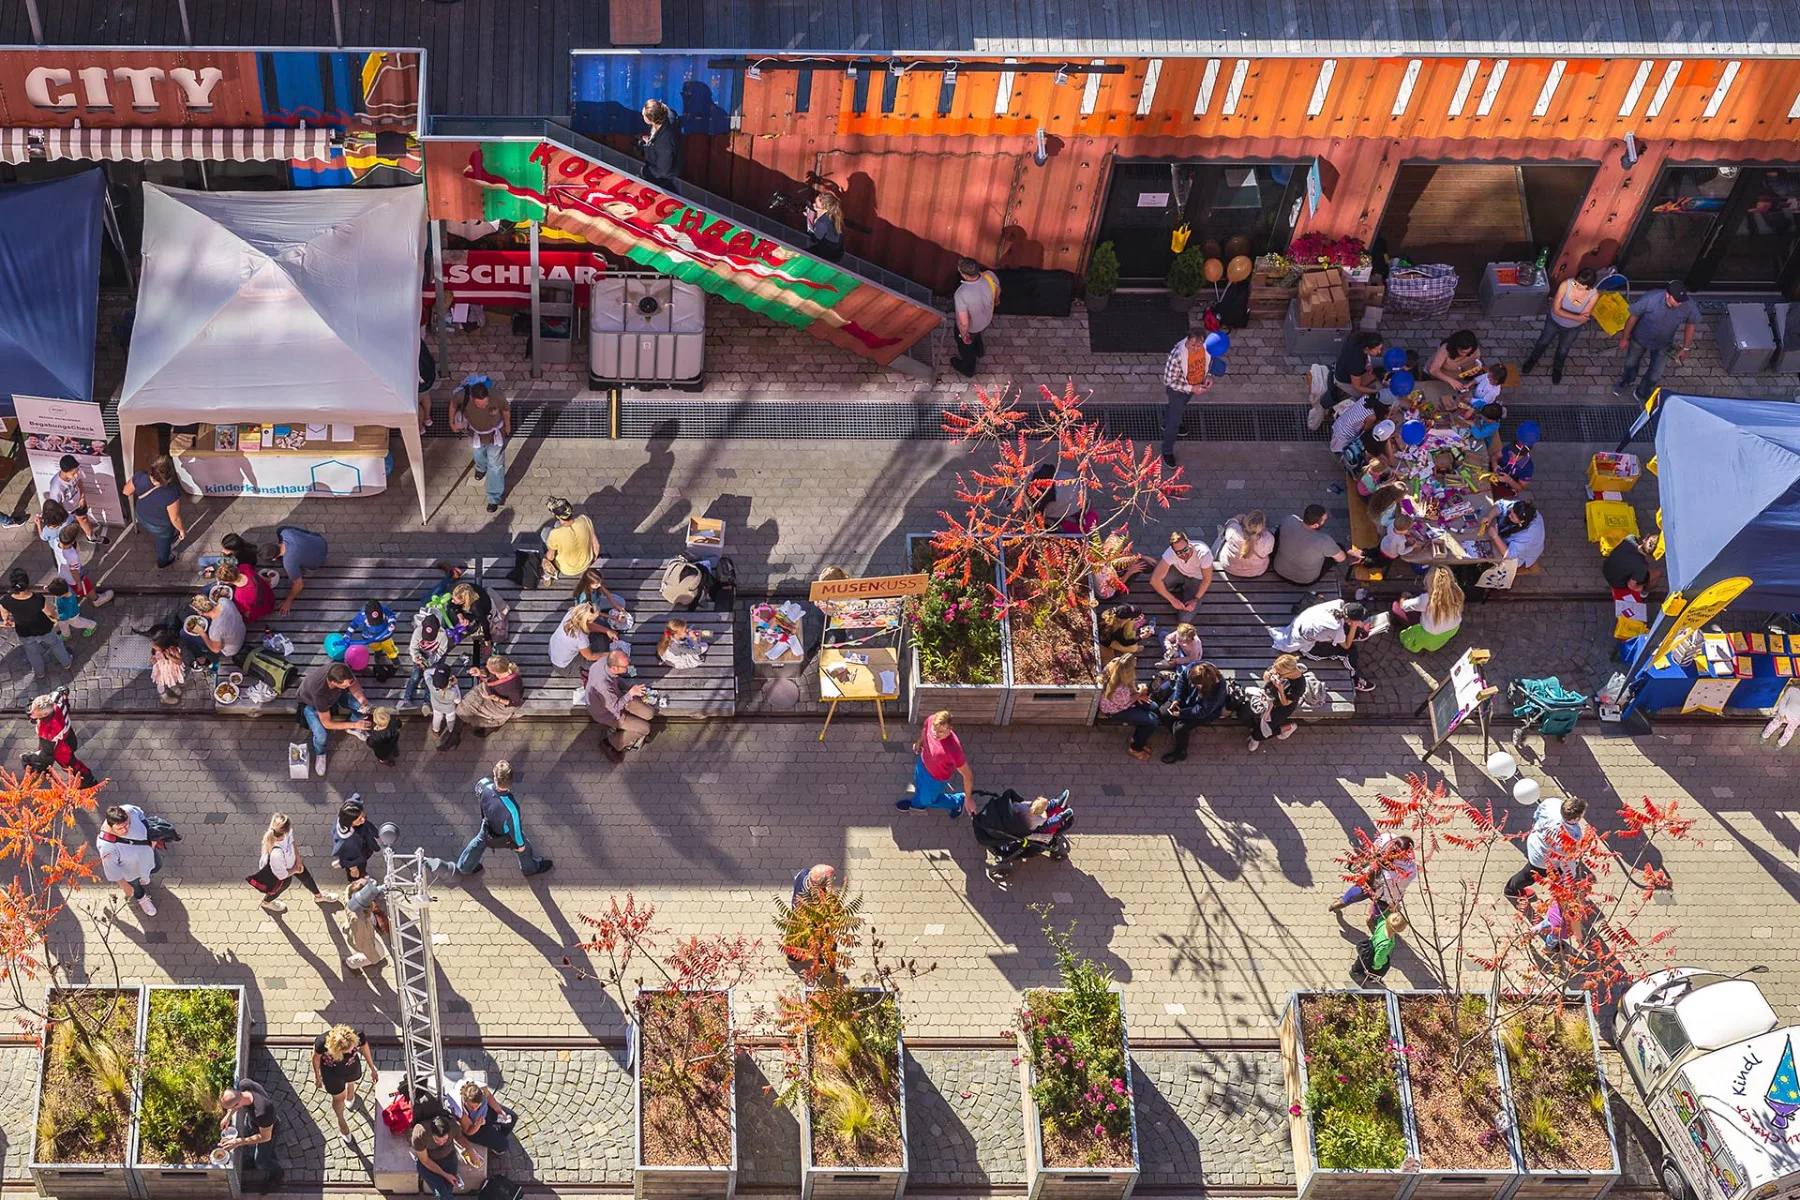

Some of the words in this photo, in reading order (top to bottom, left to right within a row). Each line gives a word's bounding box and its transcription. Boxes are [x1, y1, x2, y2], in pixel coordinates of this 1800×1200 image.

[25, 66, 224, 113] CITY
[29, 420, 95, 432] BegabungsCheck
[204, 483, 313, 495] kinderkunsthaus
[821, 579, 917, 595] MUSENKUSS
